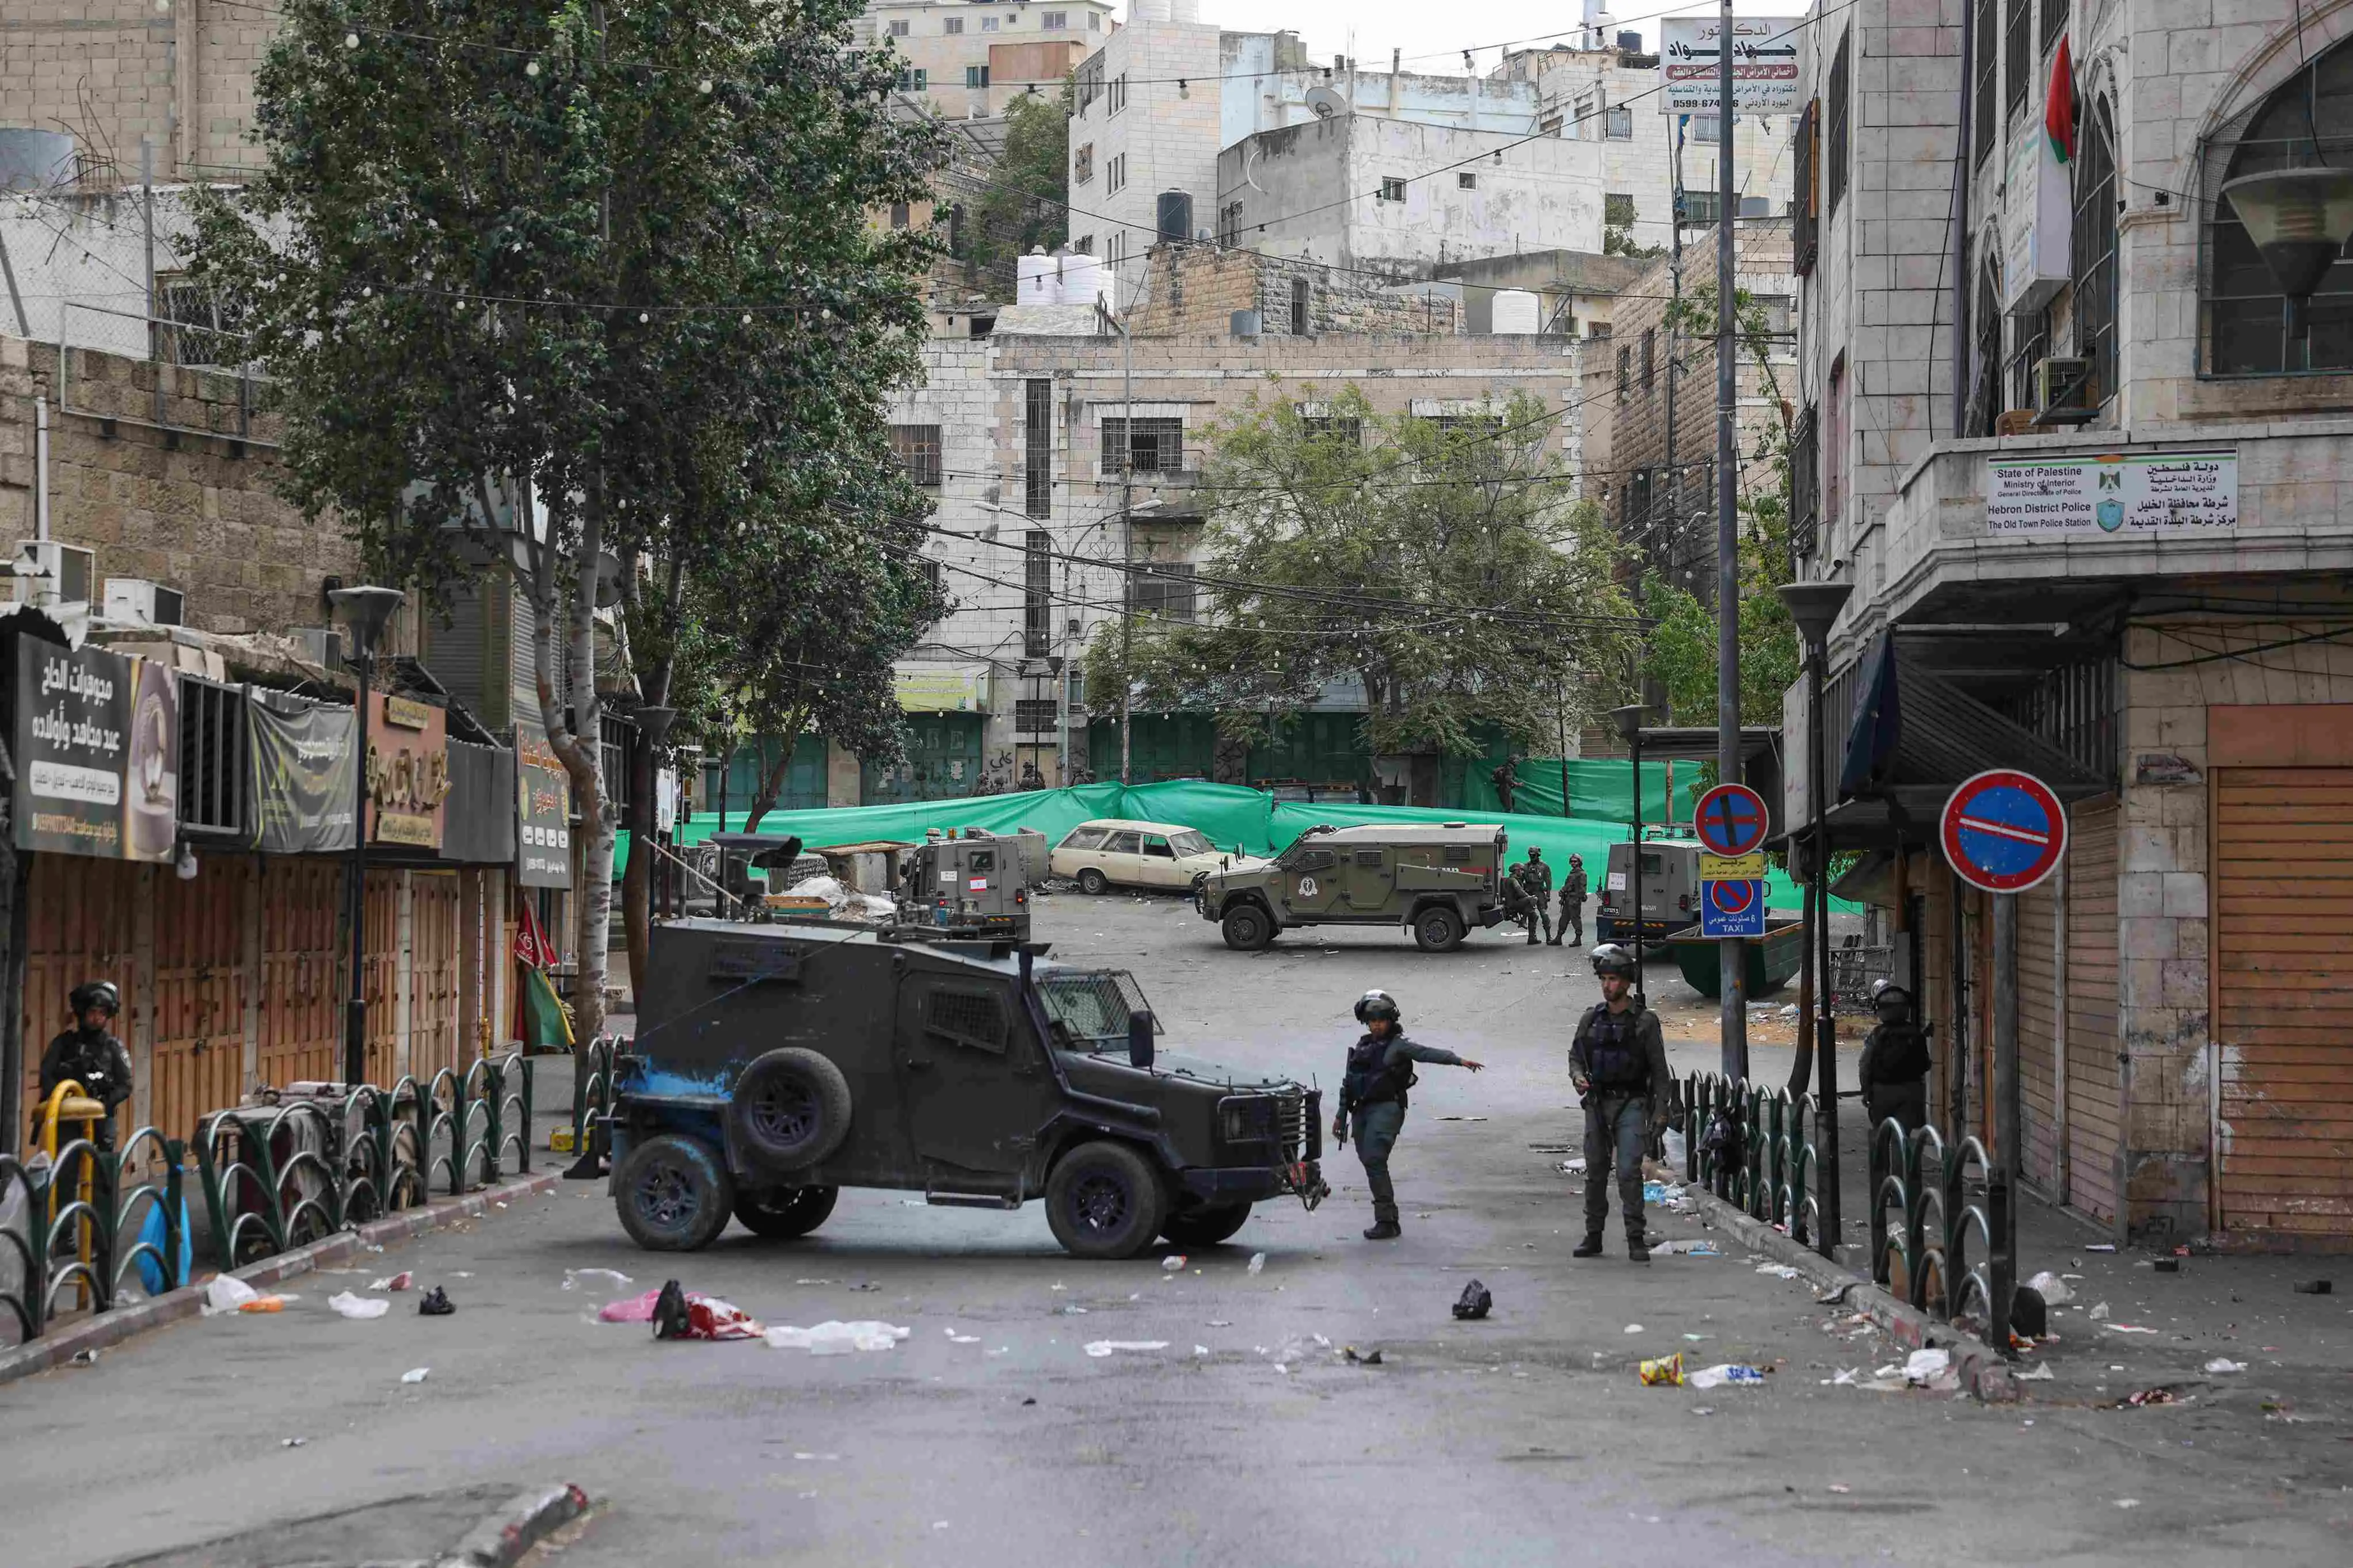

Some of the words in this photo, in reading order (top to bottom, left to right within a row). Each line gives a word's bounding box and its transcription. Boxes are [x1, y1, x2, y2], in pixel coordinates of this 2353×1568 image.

[1698, 22, 1771, 40] الدكتور
[1669, 40, 1720, 60] واد
[1762, 84, 1771, 96] في
[1673, 99, 1739, 108] 0599-6746
[1997, 469, 2021, 478] State
[2025, 468, 2035, 477] of
[2038, 467, 2082, 476] Palestine
[2147, 462, 2191, 475] فلسطين
[2194, 461, 2219, 472] دولة
[2004, 480, 2035, 489] Ministry
[2037, 479, 2045, 488] of
[2047, 479, 2076, 487] Interior
[2150, 475, 2196, 484] الداخلية
[2198, 474, 2217, 483] وزارة
[1988, 505, 2022, 514] Hebron
[2025, 503, 2059, 513] District
[2062, 502, 2091, 512] Police
[2137, 499, 2165, 512] الخليل
[2202, 495, 2229, 510] شرطة
[1989, 521, 2002, 529] The
[2004, 520, 2017, 529] Old
[2019, 520, 2039, 528] Town
[2040, 518, 2063, 528] Police
[2065, 518, 2091, 527] Station
[2130, 516, 2162, 528] القديمة
[2191, 513, 2214, 526] شرطة
[2217, 514, 2236, 526] مركز
[41, 657, 68, 697] الحاج
[70, 663, 114, 708] مجوهرات
[32, 699, 71, 751] وأولاده
[71, 715, 102, 755] مجاهد
[102, 728, 120, 759] عبد
[1751, 914, 1756, 923] 6
